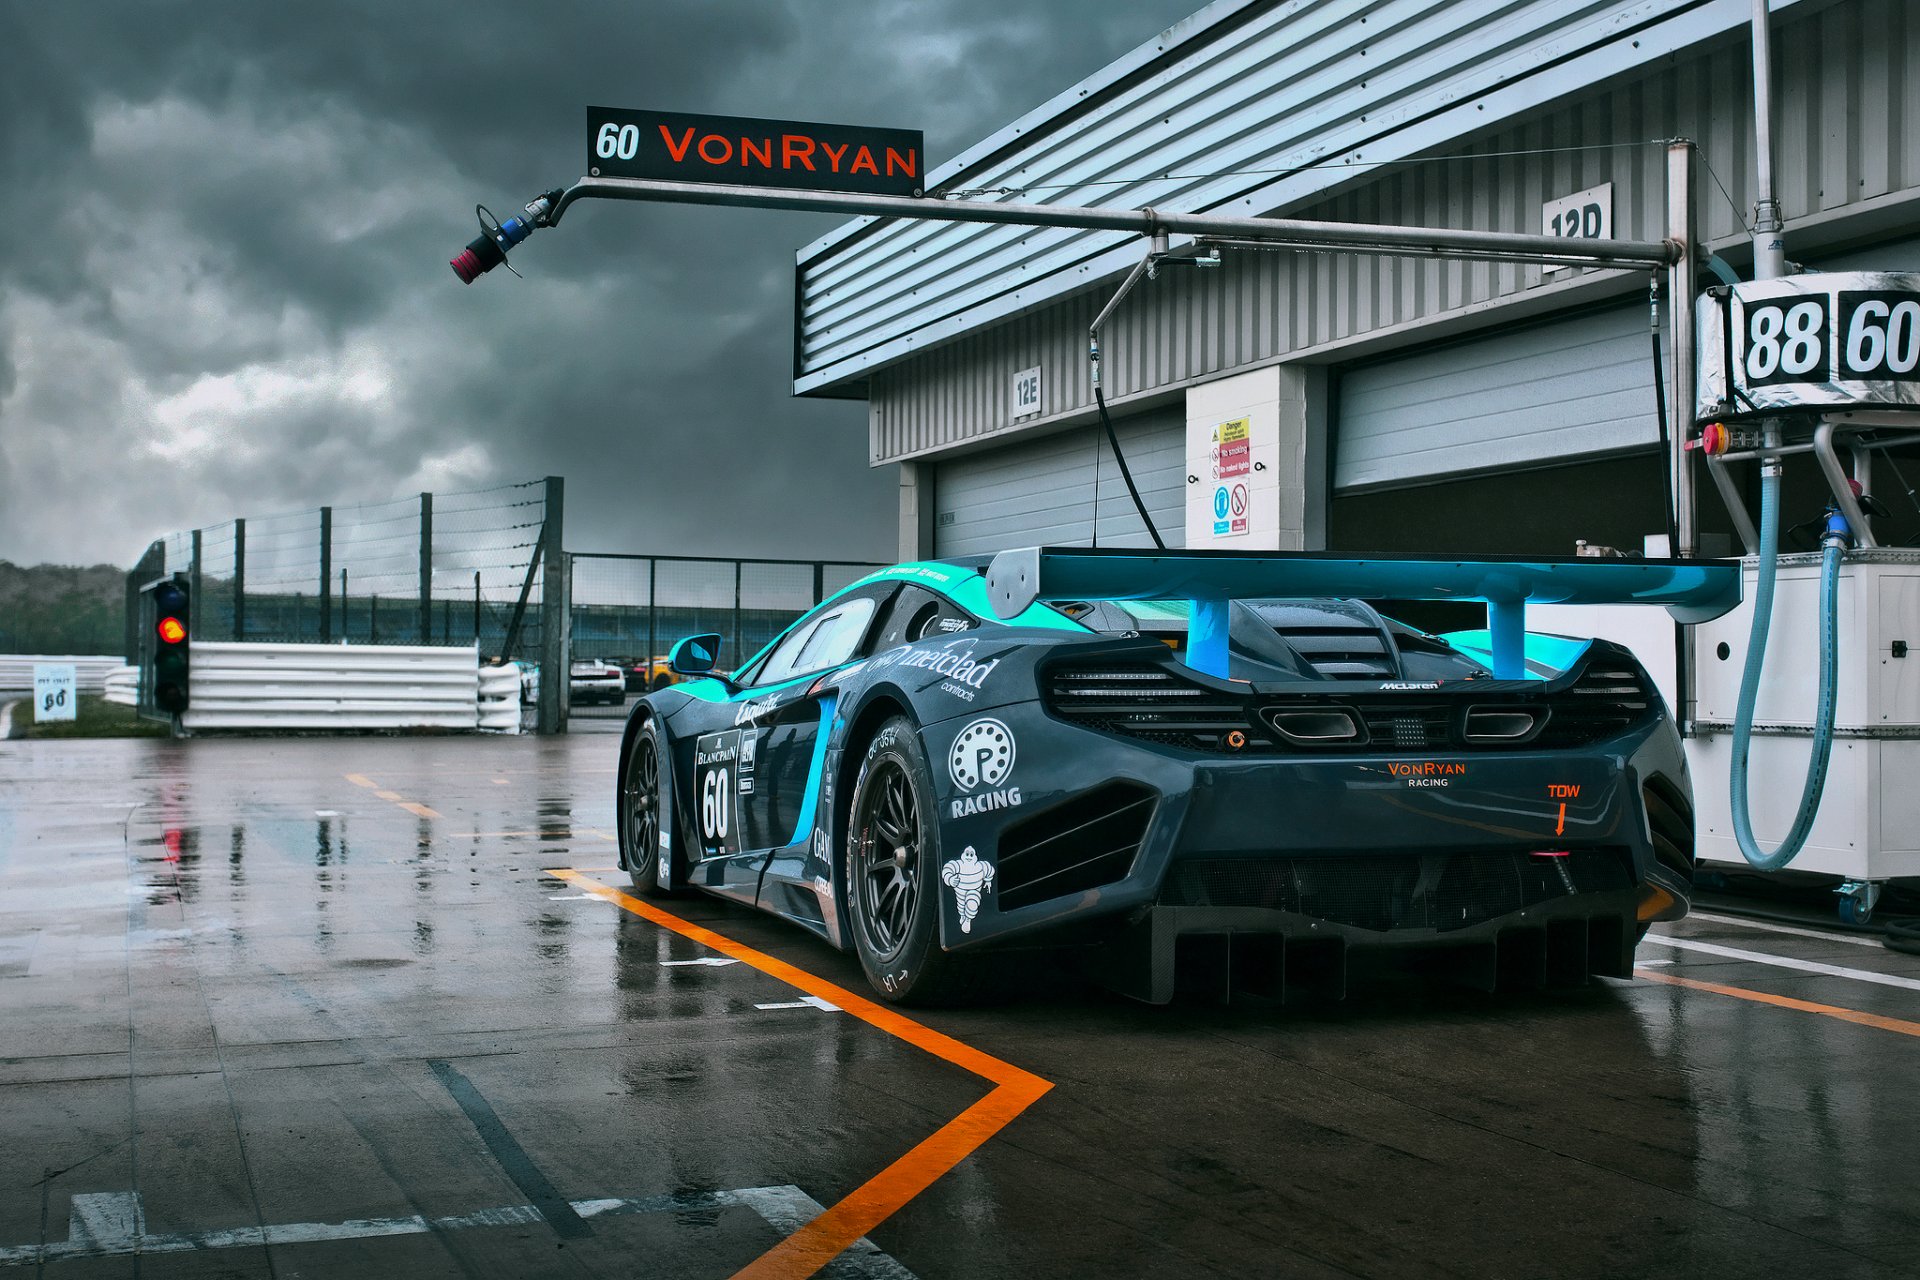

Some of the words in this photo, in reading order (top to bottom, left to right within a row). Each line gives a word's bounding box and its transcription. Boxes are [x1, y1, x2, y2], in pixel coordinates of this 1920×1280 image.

[596, 122, 639, 160] 60
[1551, 202, 1602, 239] 12D
[1747, 301, 1823, 379] 88
[1846, 300, 1920, 372] 60
[1017, 376, 1037, 406] 12E
[1226, 421, 1242, 431] Danger
[940, 682, 976, 703] contracts
[1379, 682, 1440, 690] McLaren
[697, 745, 737, 765] BLANCPAIN
[1408, 778, 1449, 787] RACING
[1547, 785, 1581, 798] TOW
[703, 767, 729, 839] 60
[951, 787, 1022, 819] RACING
